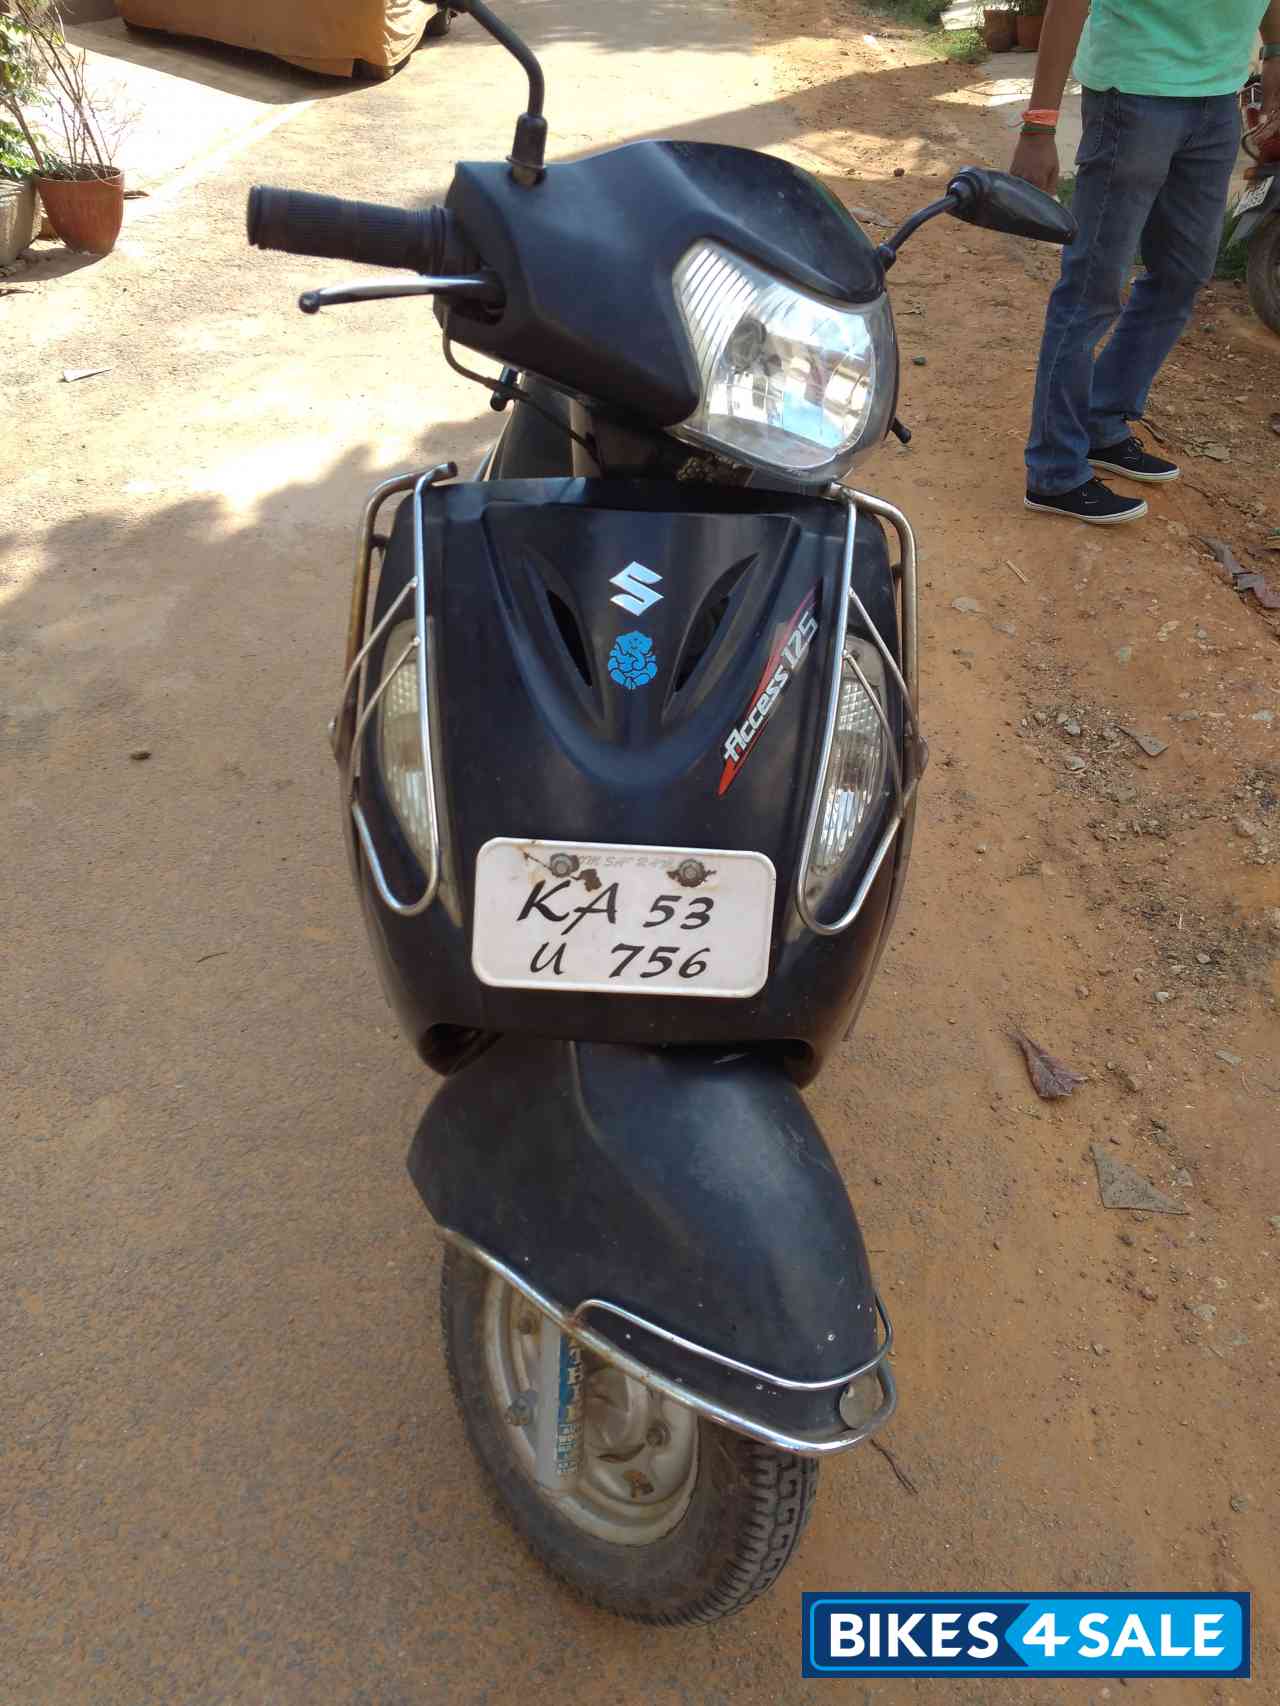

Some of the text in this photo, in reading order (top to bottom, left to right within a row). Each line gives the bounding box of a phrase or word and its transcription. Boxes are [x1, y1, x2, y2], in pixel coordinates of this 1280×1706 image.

[723, 610, 819, 762] Access 125
[516, 879, 714, 935] KA 53
[608, 943, 711, 979] 756
